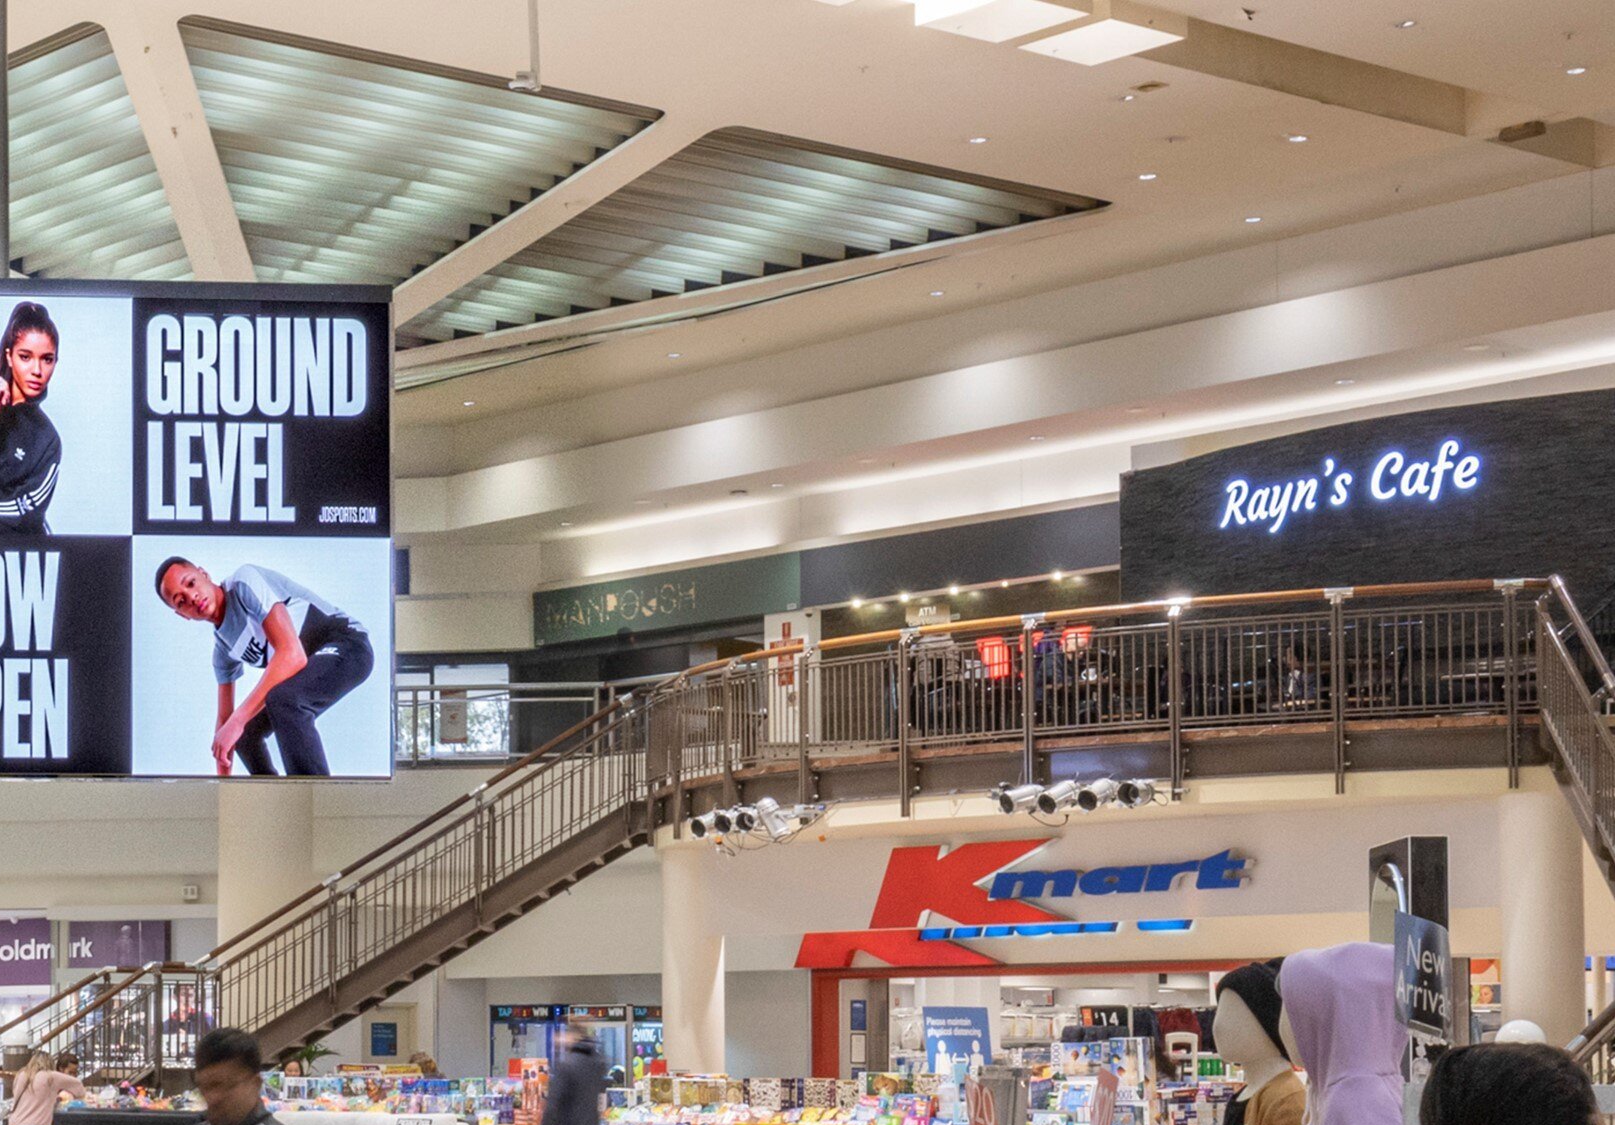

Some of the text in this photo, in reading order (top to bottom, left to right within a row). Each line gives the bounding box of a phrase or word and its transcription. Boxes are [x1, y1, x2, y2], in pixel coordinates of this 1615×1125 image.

[147, 314, 367, 416] GROUND
[148, 421, 296, 523] LEVEL
[1220, 440, 1479, 533] Rayn's Cafe
[319, 506, 377, 523] JDSPORTS.COM
[918, 606, 937, 617] ATM
[241, 636, 266, 665] NIKE
[1406, 934, 1445, 974] New
